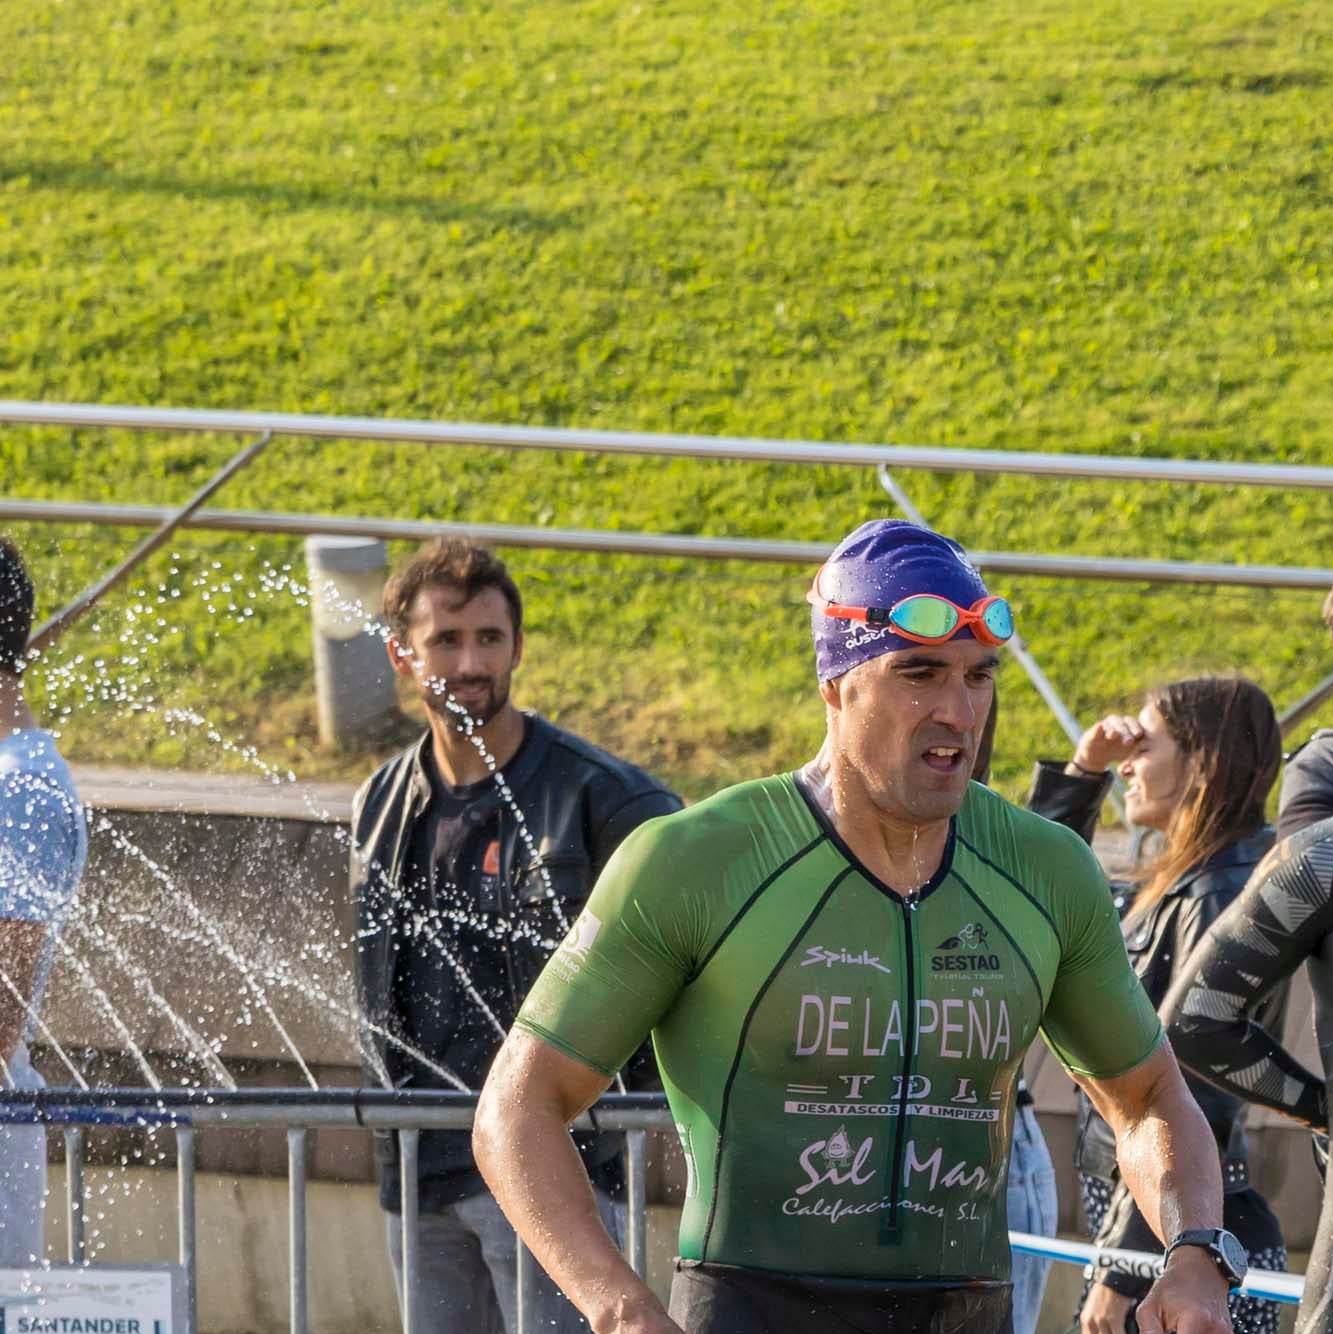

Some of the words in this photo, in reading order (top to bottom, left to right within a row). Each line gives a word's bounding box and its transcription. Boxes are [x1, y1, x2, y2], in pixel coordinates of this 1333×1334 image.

[800, 945, 891, 973] Spiuk
[931, 954, 1001, 971] SESTAO
[796, 994, 852, 1057] DE
[863, 996, 904, 1058] LA
[914, 986, 1011, 1061] PEÑA
[797, 1103, 898, 1115] DESATASCOS
[912, 1104, 923, 1114] Y
[928, 1105, 995, 1121] LIMPIEZAS
